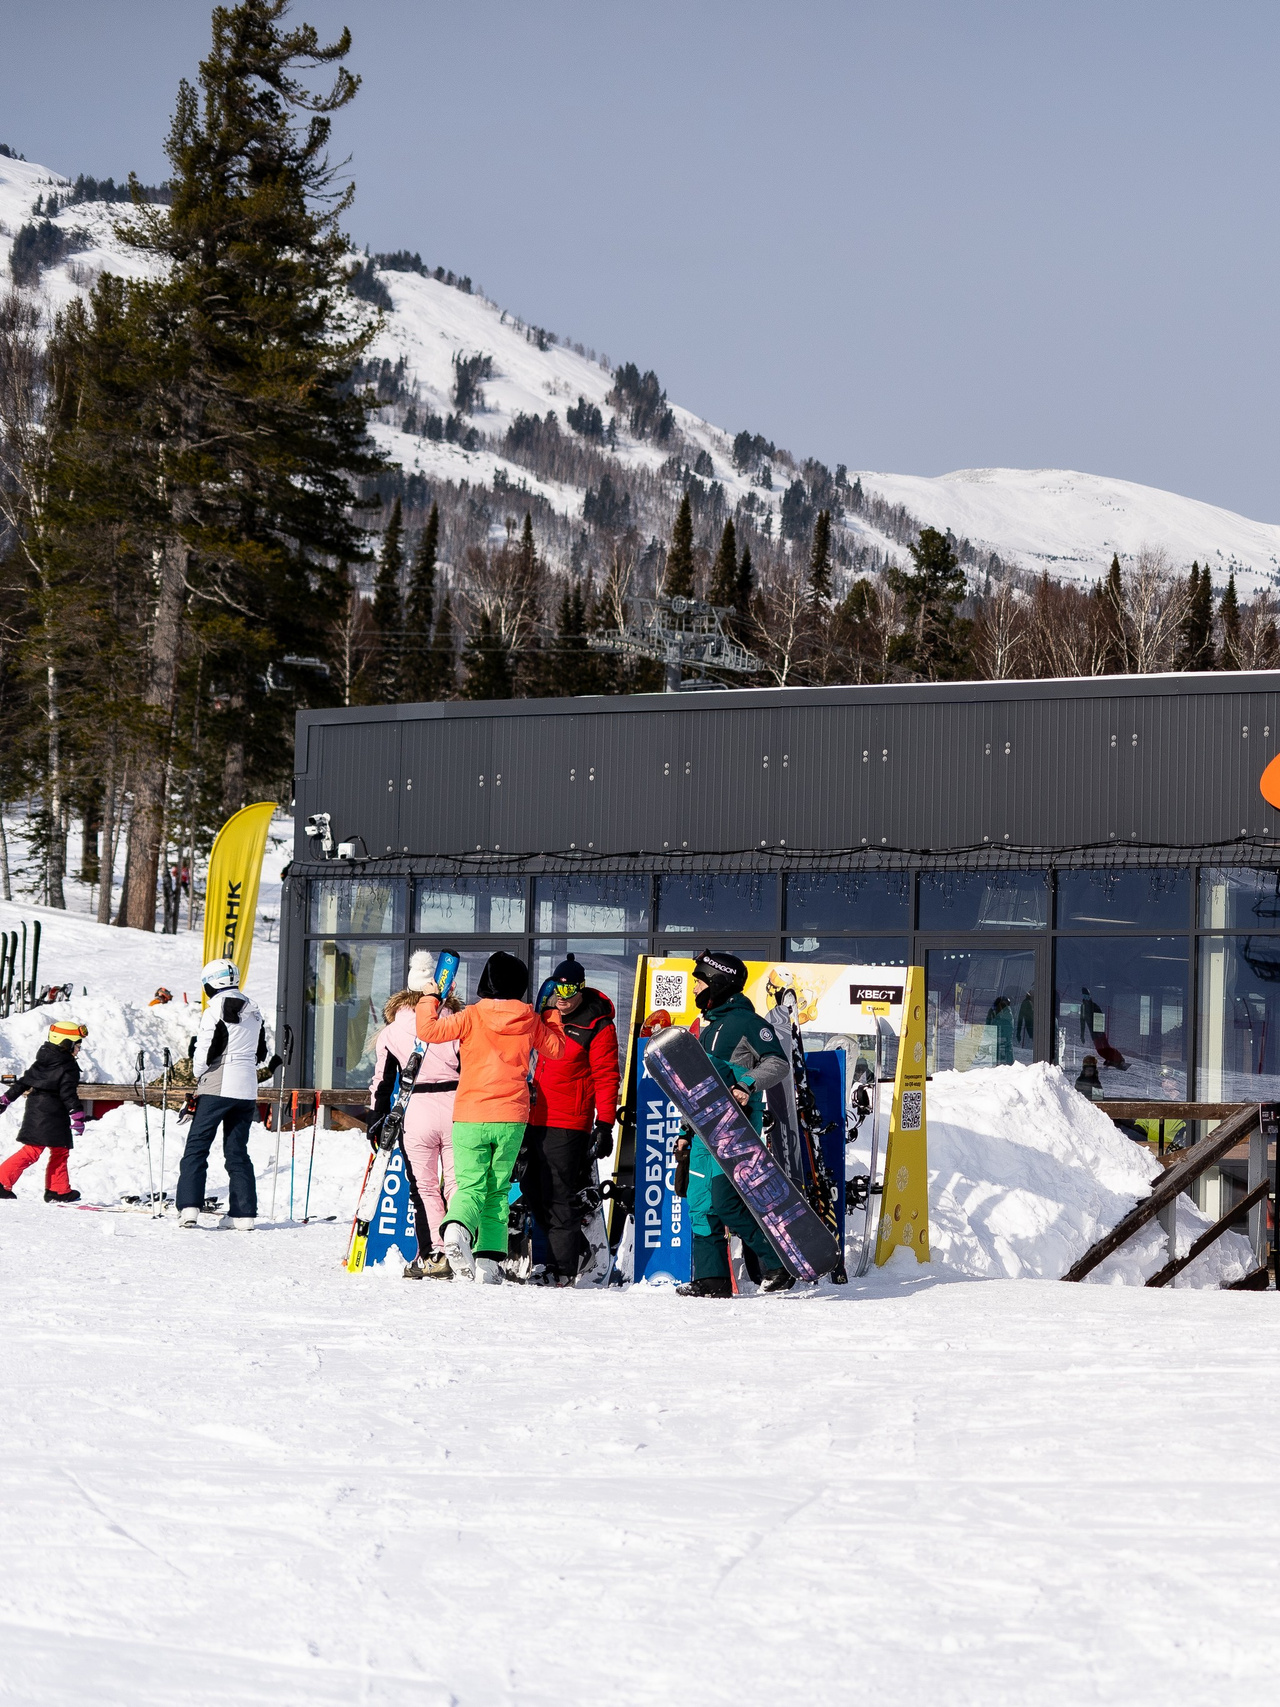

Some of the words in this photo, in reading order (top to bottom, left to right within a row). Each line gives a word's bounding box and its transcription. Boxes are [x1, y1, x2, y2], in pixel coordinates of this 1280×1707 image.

[708, 959, 737, 975] DRAGON
[856, 989, 896, 1001] КВЕСТ
[644, 1100, 664, 1248] ПРОБУДИ
[653, 1048, 817, 1281] TERMIT
[671, 1195, 682, 1234] СЕБЕ
[671, 1237, 682, 1247] В
